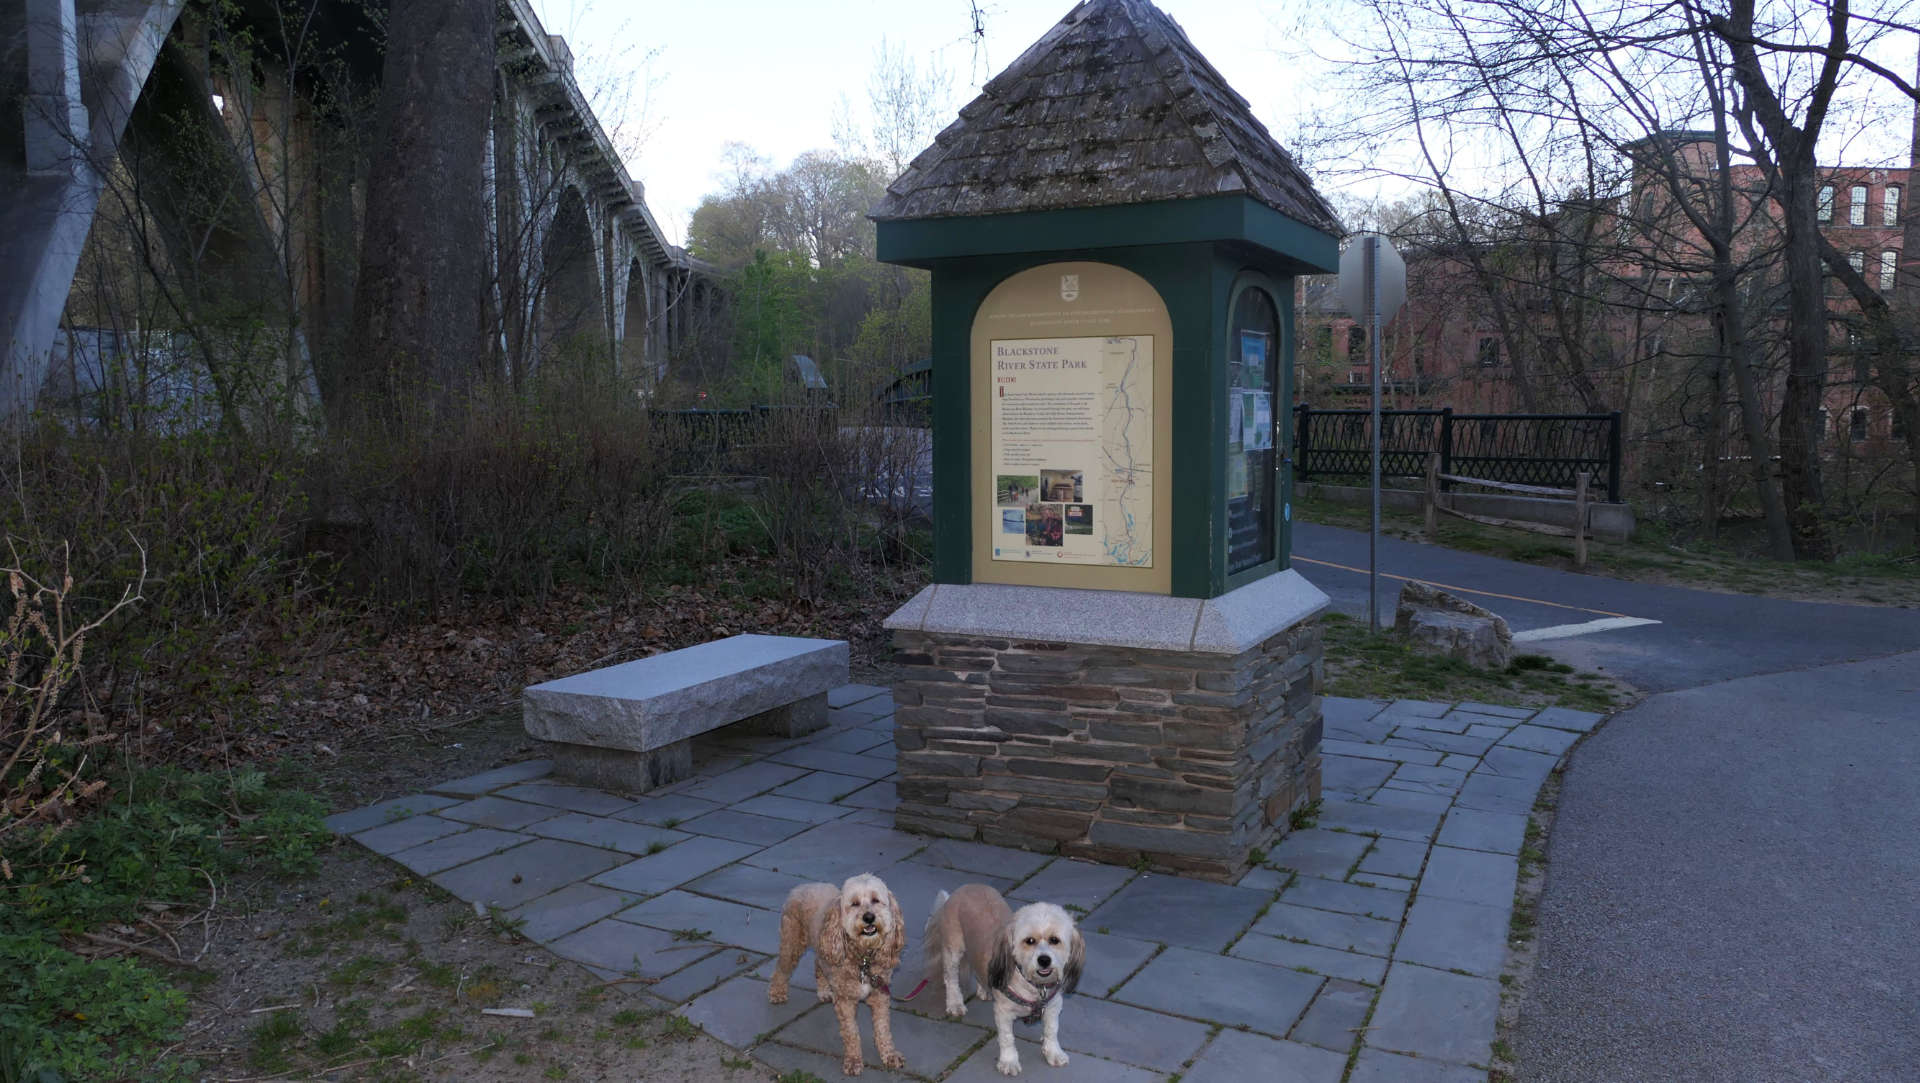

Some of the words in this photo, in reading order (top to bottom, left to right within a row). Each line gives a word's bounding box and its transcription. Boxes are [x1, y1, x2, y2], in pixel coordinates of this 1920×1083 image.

[997, 346, 1058, 357] BLACKSTONE
[997, 360, 1027, 370] RIVER
[1028, 360, 1059, 370] STATE
[1062, 359, 1088, 369] PARK
